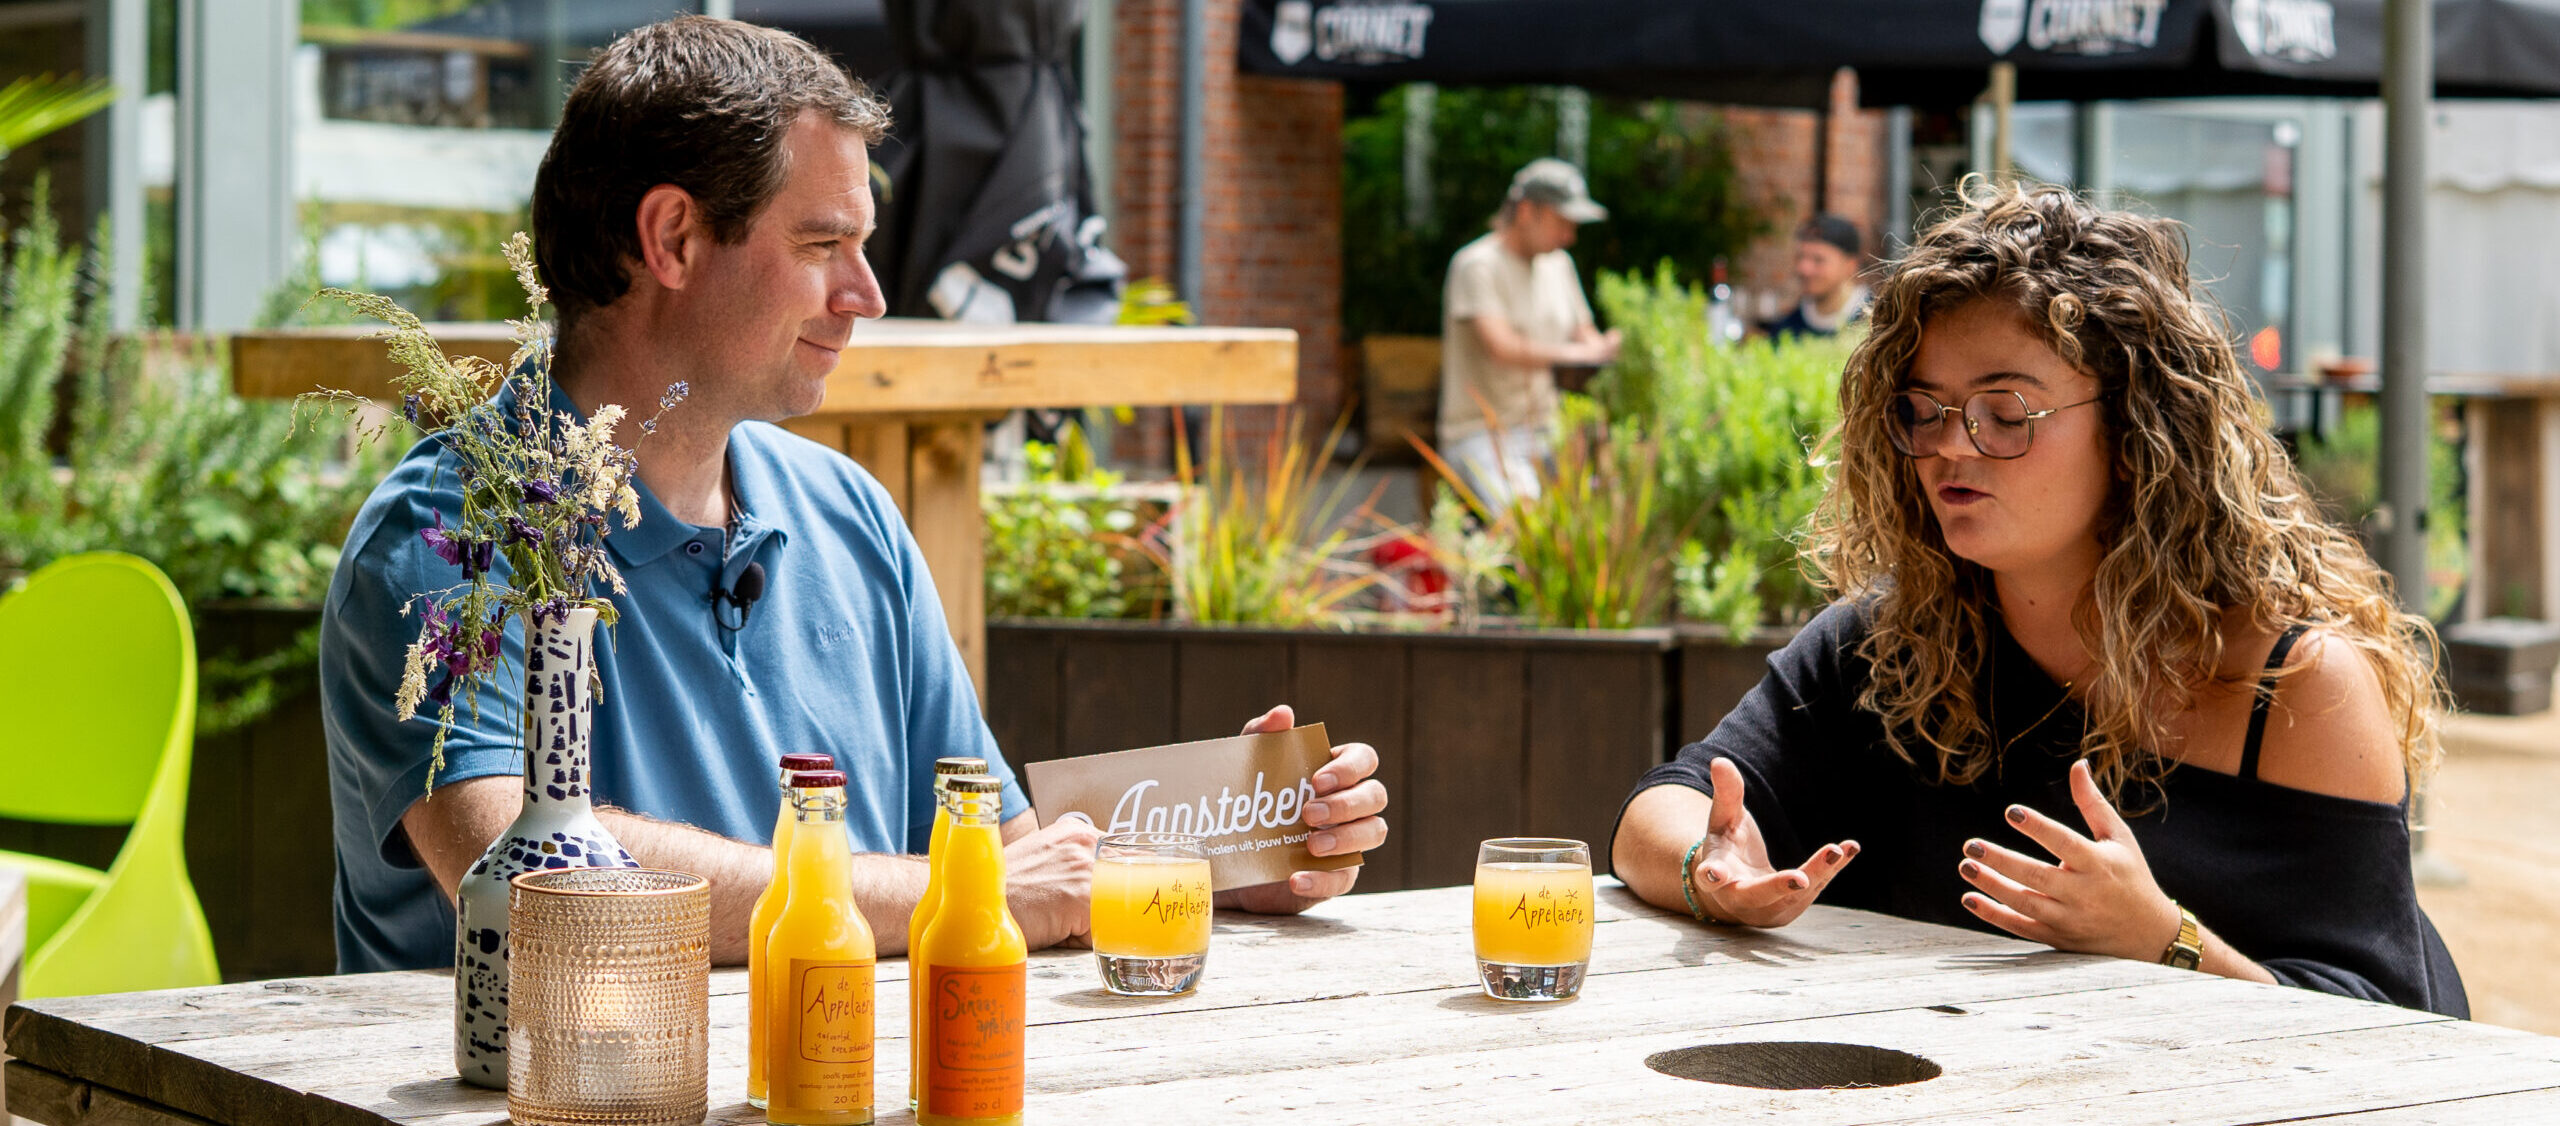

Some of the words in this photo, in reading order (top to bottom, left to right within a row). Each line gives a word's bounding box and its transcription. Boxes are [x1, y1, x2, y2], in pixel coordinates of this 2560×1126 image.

[1238, 840, 1253, 850] uit
[1255, 837, 1282, 851] jouw
[1171, 879, 1183, 893] de
[1538, 885, 1550, 900] de
[1143, 887, 1210, 924] Appelaere
[1509, 893, 1584, 930] Appelaere
[837, 975, 849, 991] de
[833, 1095, 848, 1104] 20
[851, 1090, 860, 1103] cl
